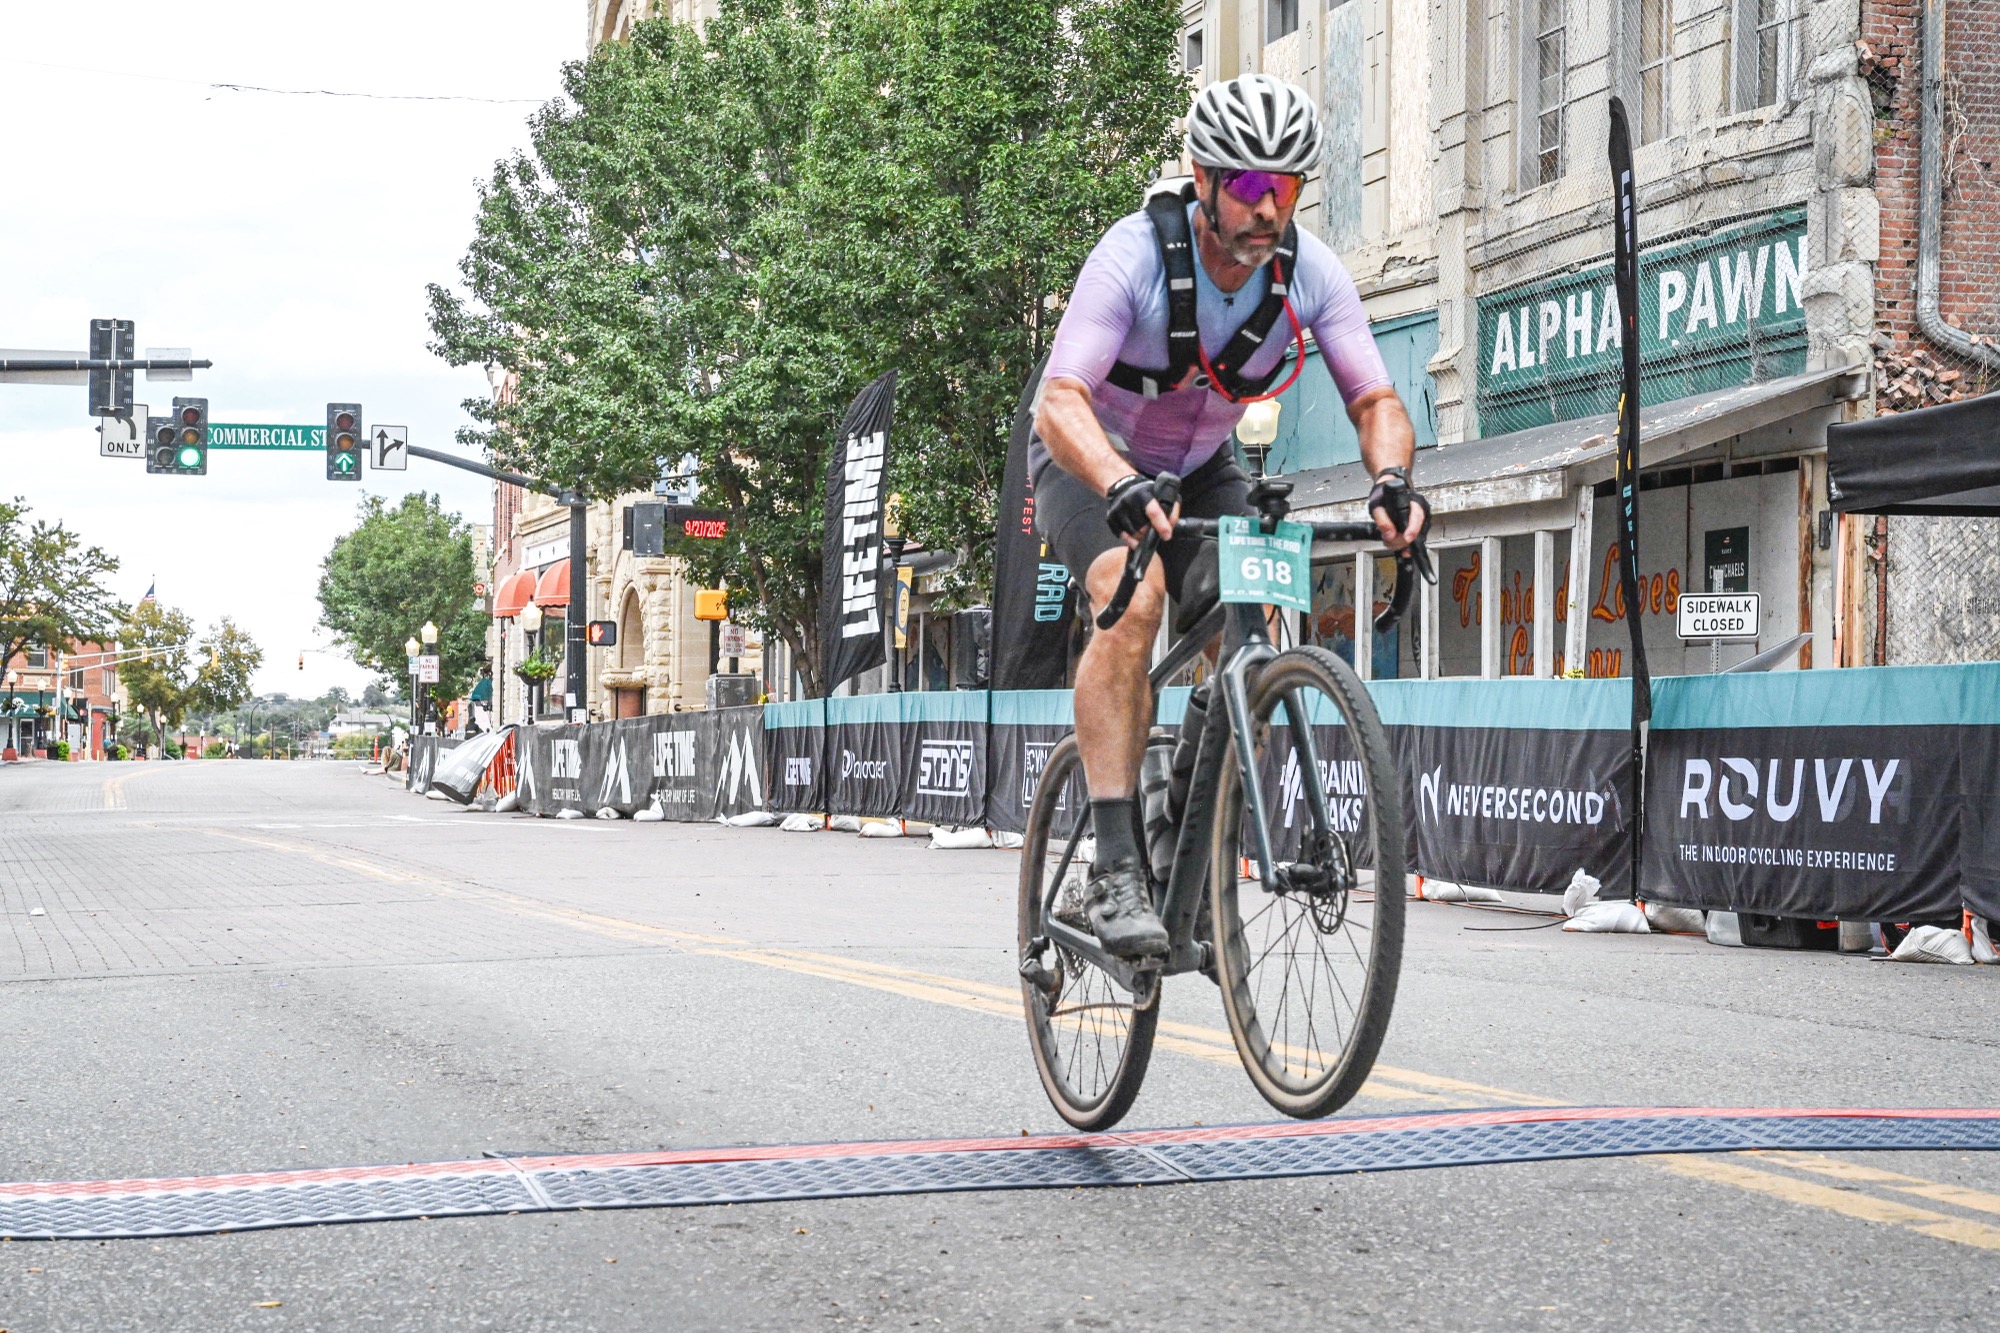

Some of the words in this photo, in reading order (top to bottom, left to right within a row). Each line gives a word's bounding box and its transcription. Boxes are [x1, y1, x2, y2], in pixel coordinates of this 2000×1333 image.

[1491, 284, 1623, 375] ALPHA
[1659, 235, 1808, 340] PAWN
[107, 442, 140, 454] ONLY
[207, 427, 306, 447] COMMERCIAL
[1022, 497, 1034, 535] FEST
[1241, 556, 1292, 585] 618
[1035, 563, 1069, 622] RAD
[1686, 600, 1752, 614] SIDEWALK
[1693, 618, 1744, 631] CLOSED
[1447, 784, 1604, 825] NEVERSECOND
[1680, 757, 1900, 824] ROUVY
[1679, 844, 1698, 862] THE
[1702, 845, 1746, 864] INDOOR
[1750, 848, 1803, 866] CYCLING
[1807, 850, 1896, 871] EXPERIENCE
